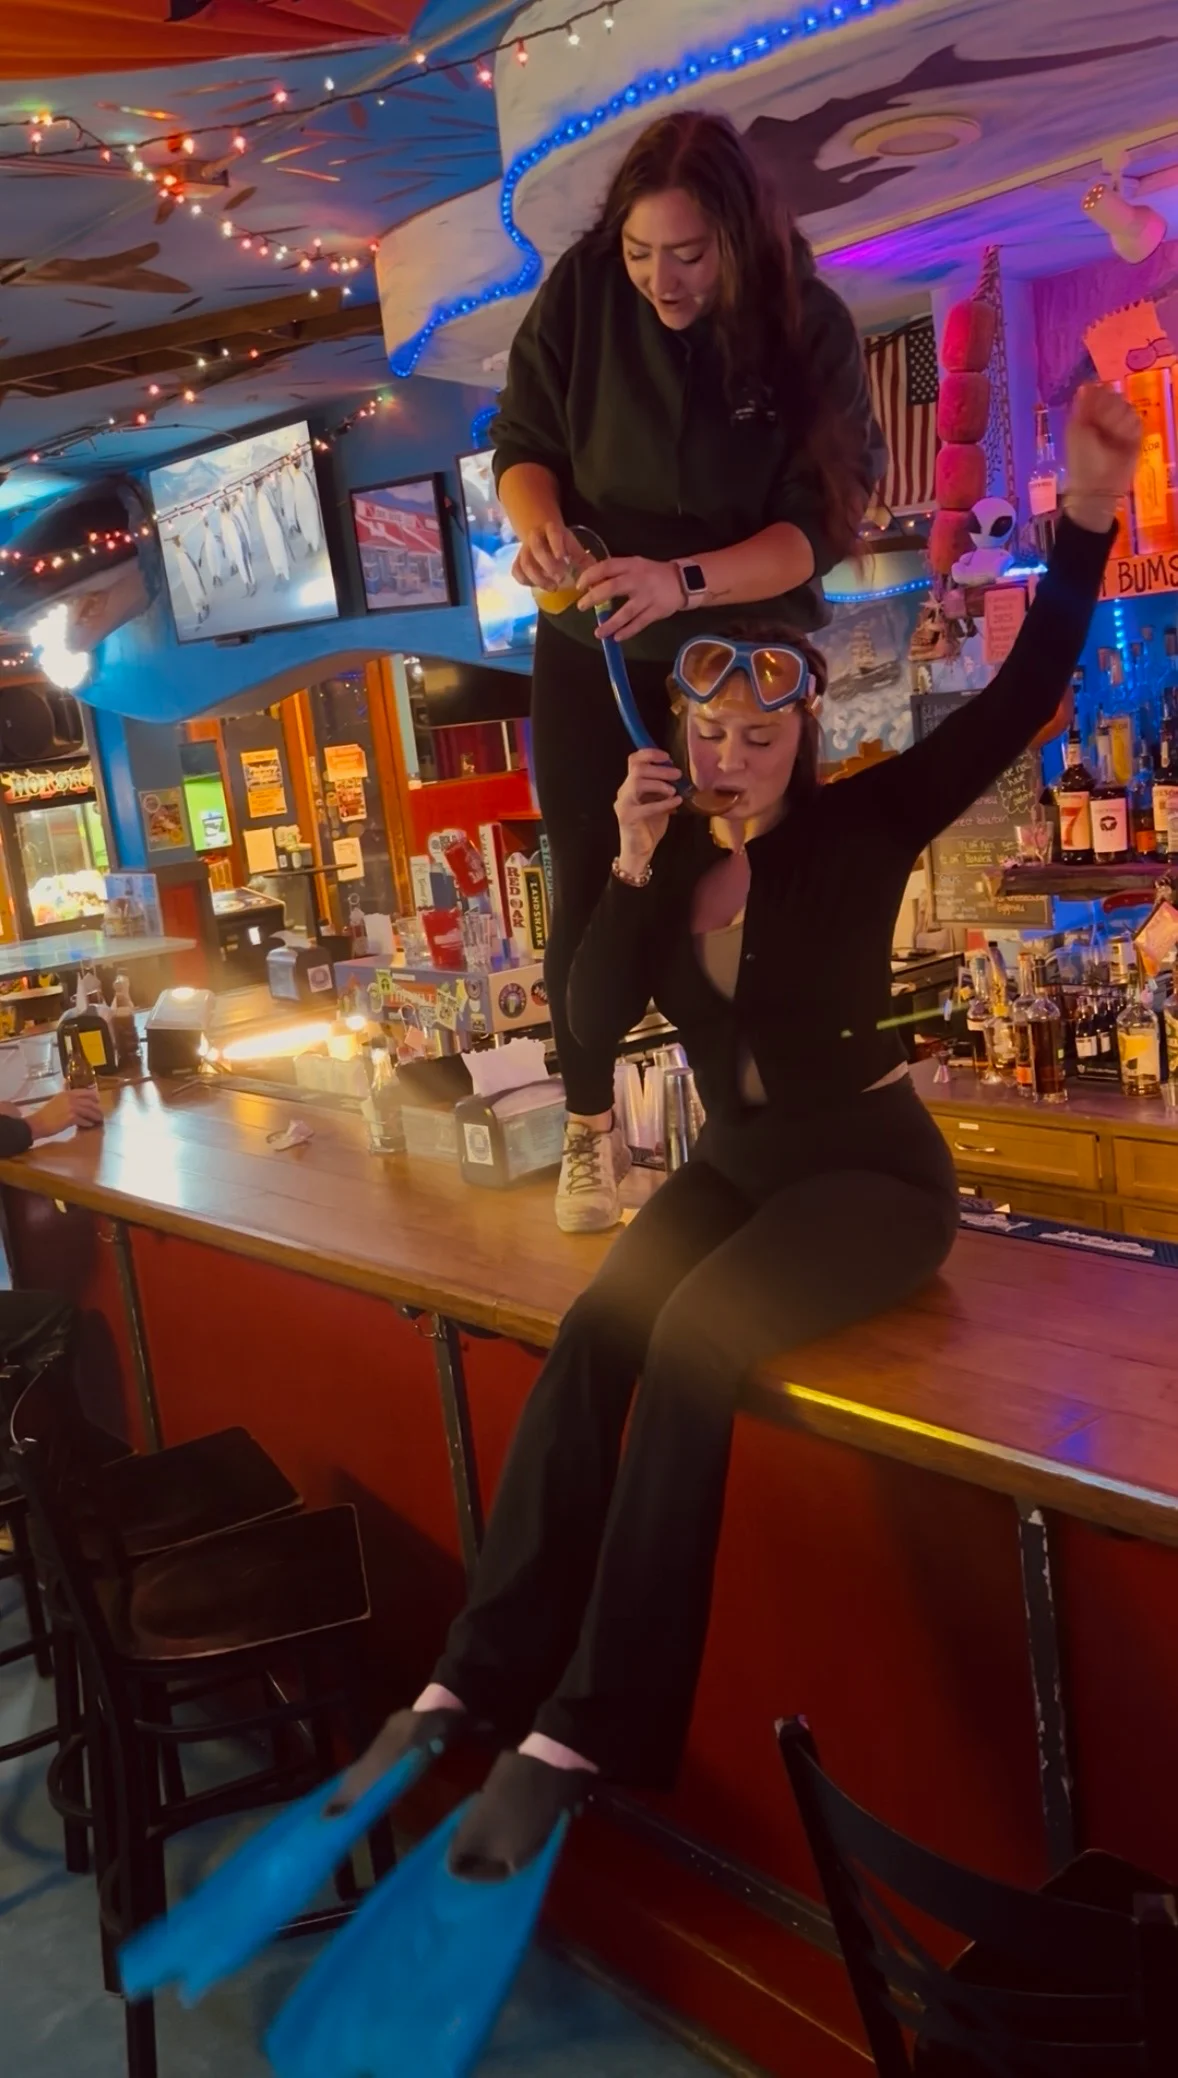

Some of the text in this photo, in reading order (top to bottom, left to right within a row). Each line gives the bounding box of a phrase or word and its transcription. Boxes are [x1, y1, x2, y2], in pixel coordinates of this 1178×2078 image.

[1118, 554, 1178, 594] BUMS
[1060, 806, 1082, 847] 7
[506, 866, 521, 896] RED
[528, 881, 545, 947] LANDSHARK
